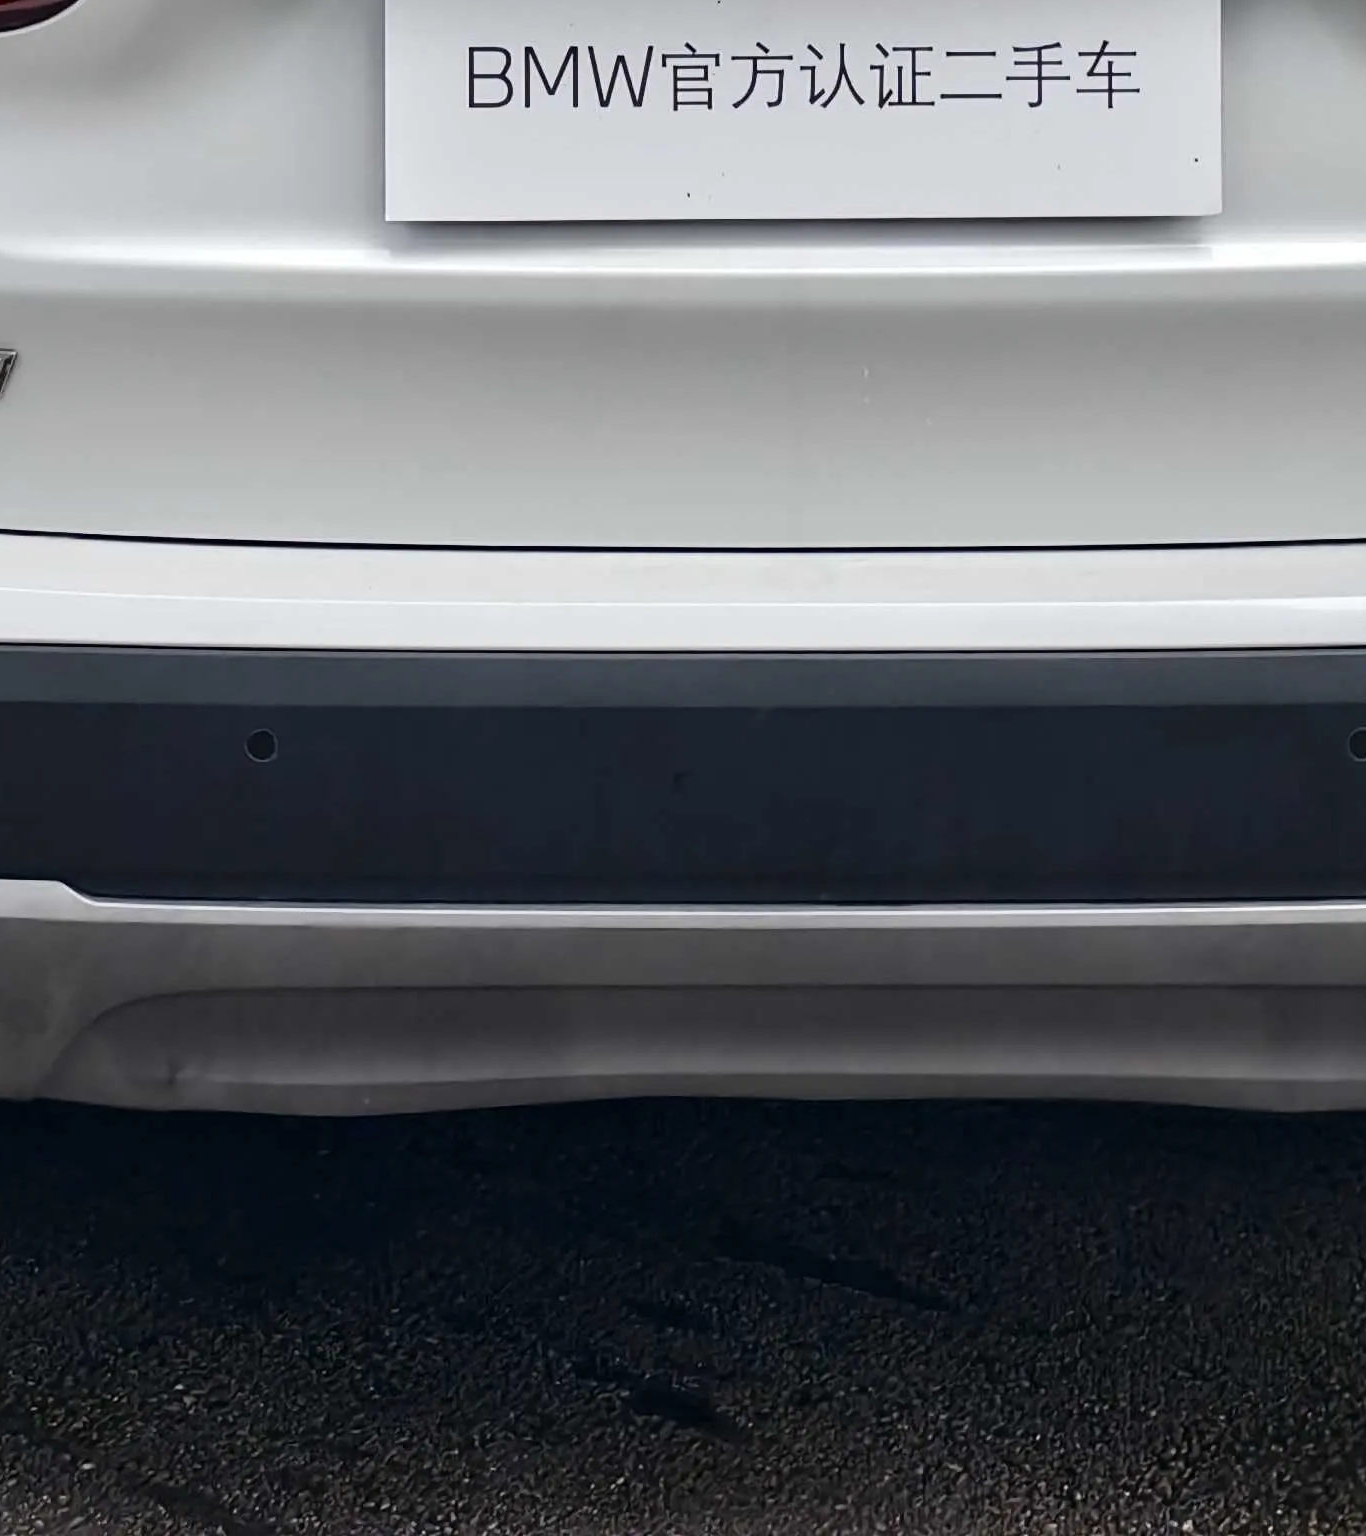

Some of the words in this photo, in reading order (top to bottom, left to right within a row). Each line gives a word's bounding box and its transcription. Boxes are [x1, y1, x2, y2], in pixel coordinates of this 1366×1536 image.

[466, 40, 1141, 110] BMW官方认证二手车
